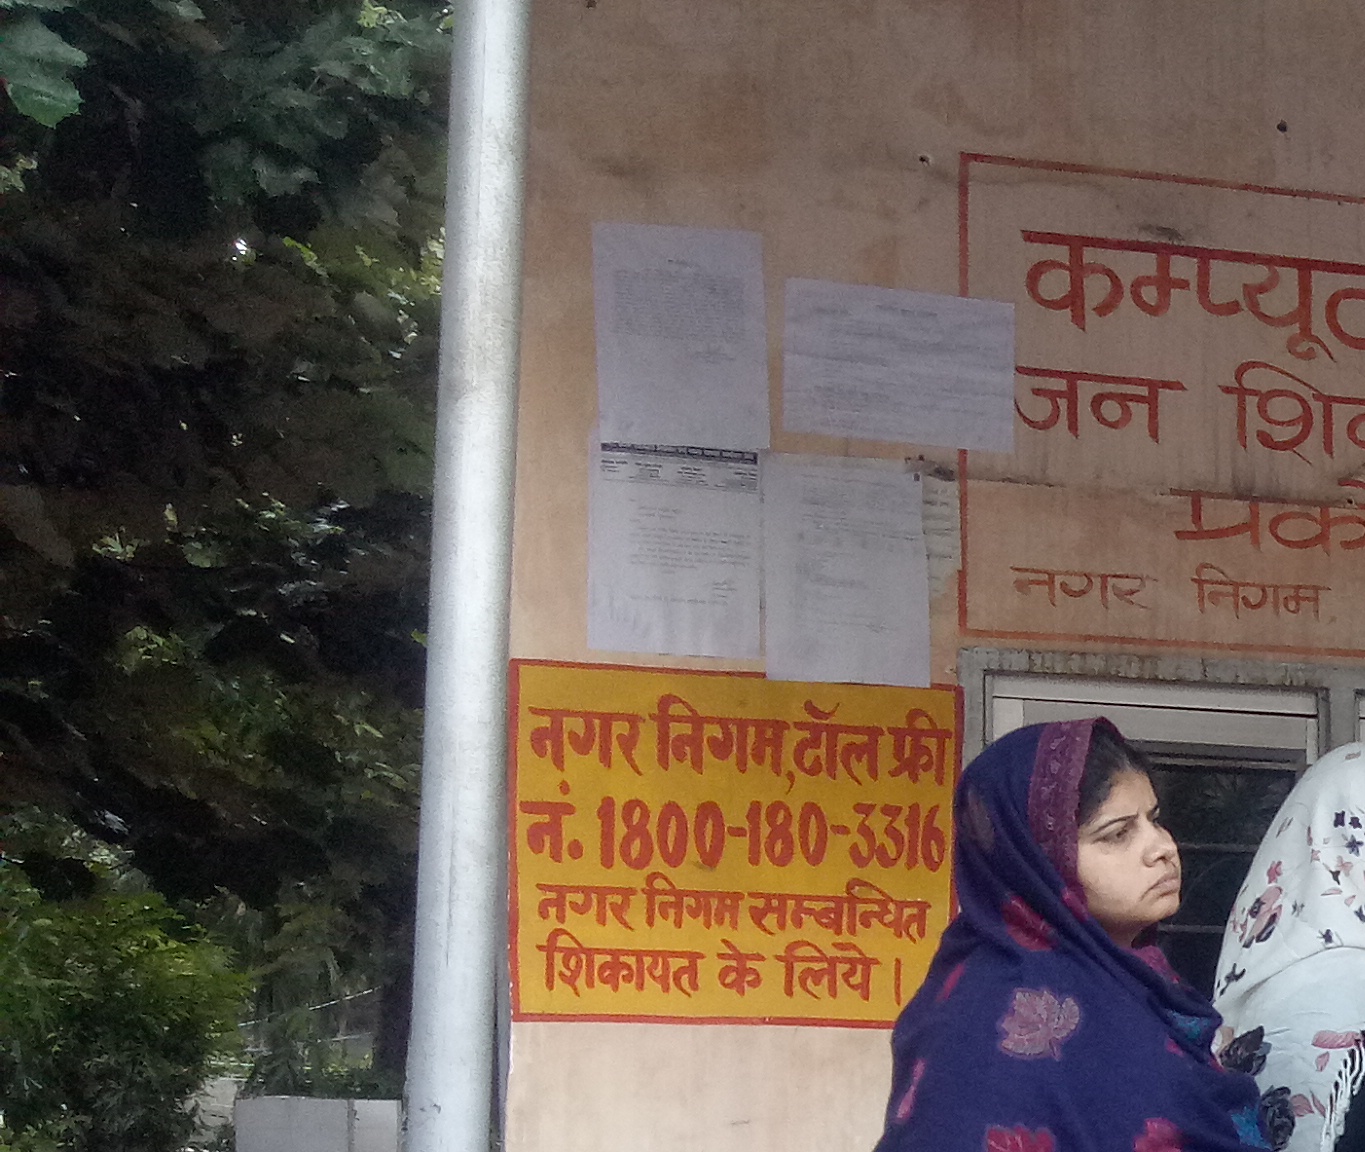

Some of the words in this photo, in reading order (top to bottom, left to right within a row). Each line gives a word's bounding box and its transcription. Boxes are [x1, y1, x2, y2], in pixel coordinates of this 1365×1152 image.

[1014, 364, 1187, 444] जन
[1010, 565, 1160, 612] नगर
[1191, 562, 1332, 626] निगम
[527, 706, 645, 777] नगर
[793, 700, 885, 787] टॉल
[885, 708, 953, 786] फ्री
[595, 795, 948, 873] 1800-180-3316
[536, 882, 639, 932] नगर
[641, 871, 746, 931] निगम
[747, 877, 932, 944] सम्बन्धित
[536, 928, 705, 998] शिकायत
[716, 937, 765, 998] के
[776, 940, 882, 1002] लिये
